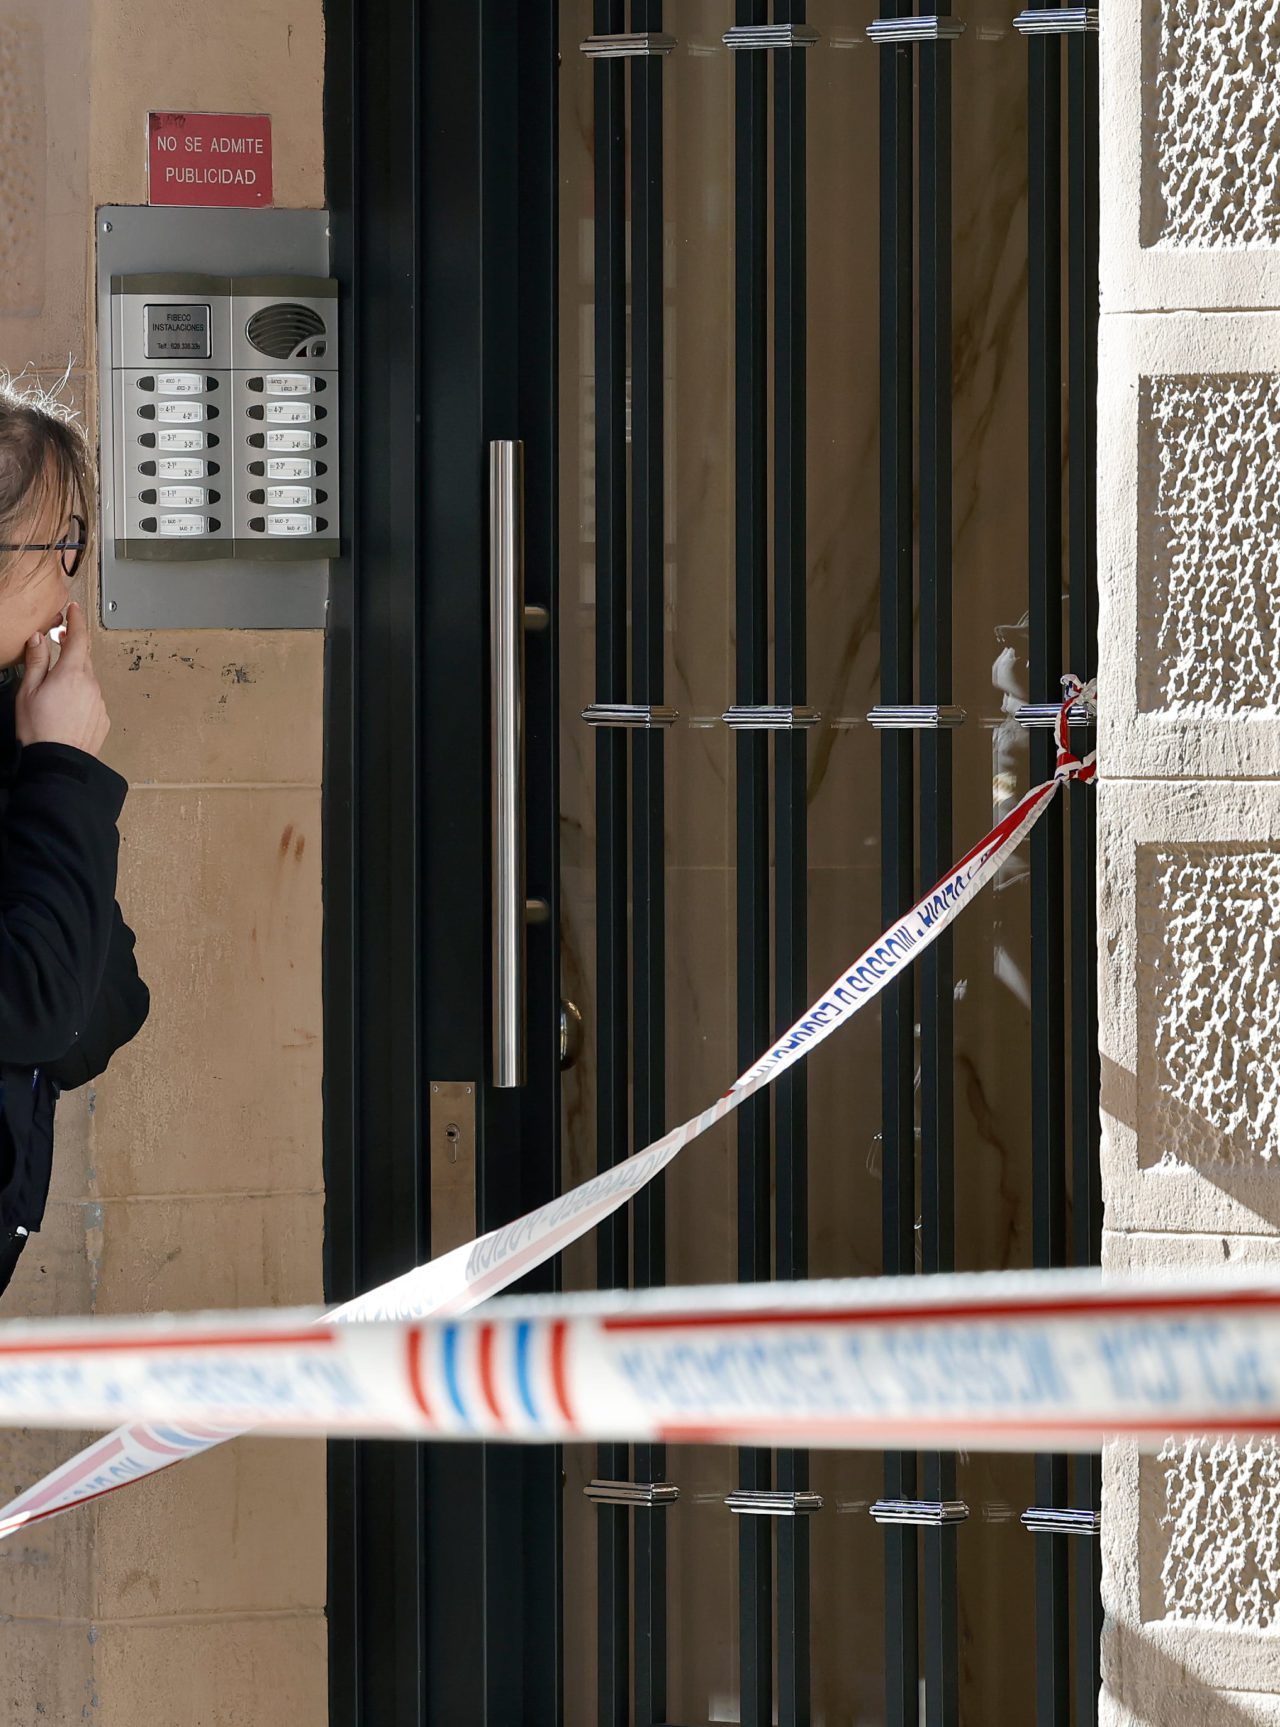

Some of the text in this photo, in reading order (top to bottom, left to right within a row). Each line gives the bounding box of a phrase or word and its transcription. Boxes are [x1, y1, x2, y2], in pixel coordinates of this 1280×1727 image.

[157, 136, 264, 154] NO SE ADMITE
[166, 167, 256, 185] PUBLICIDAD
[152, 323, 205, 332] INSTALACIONES
